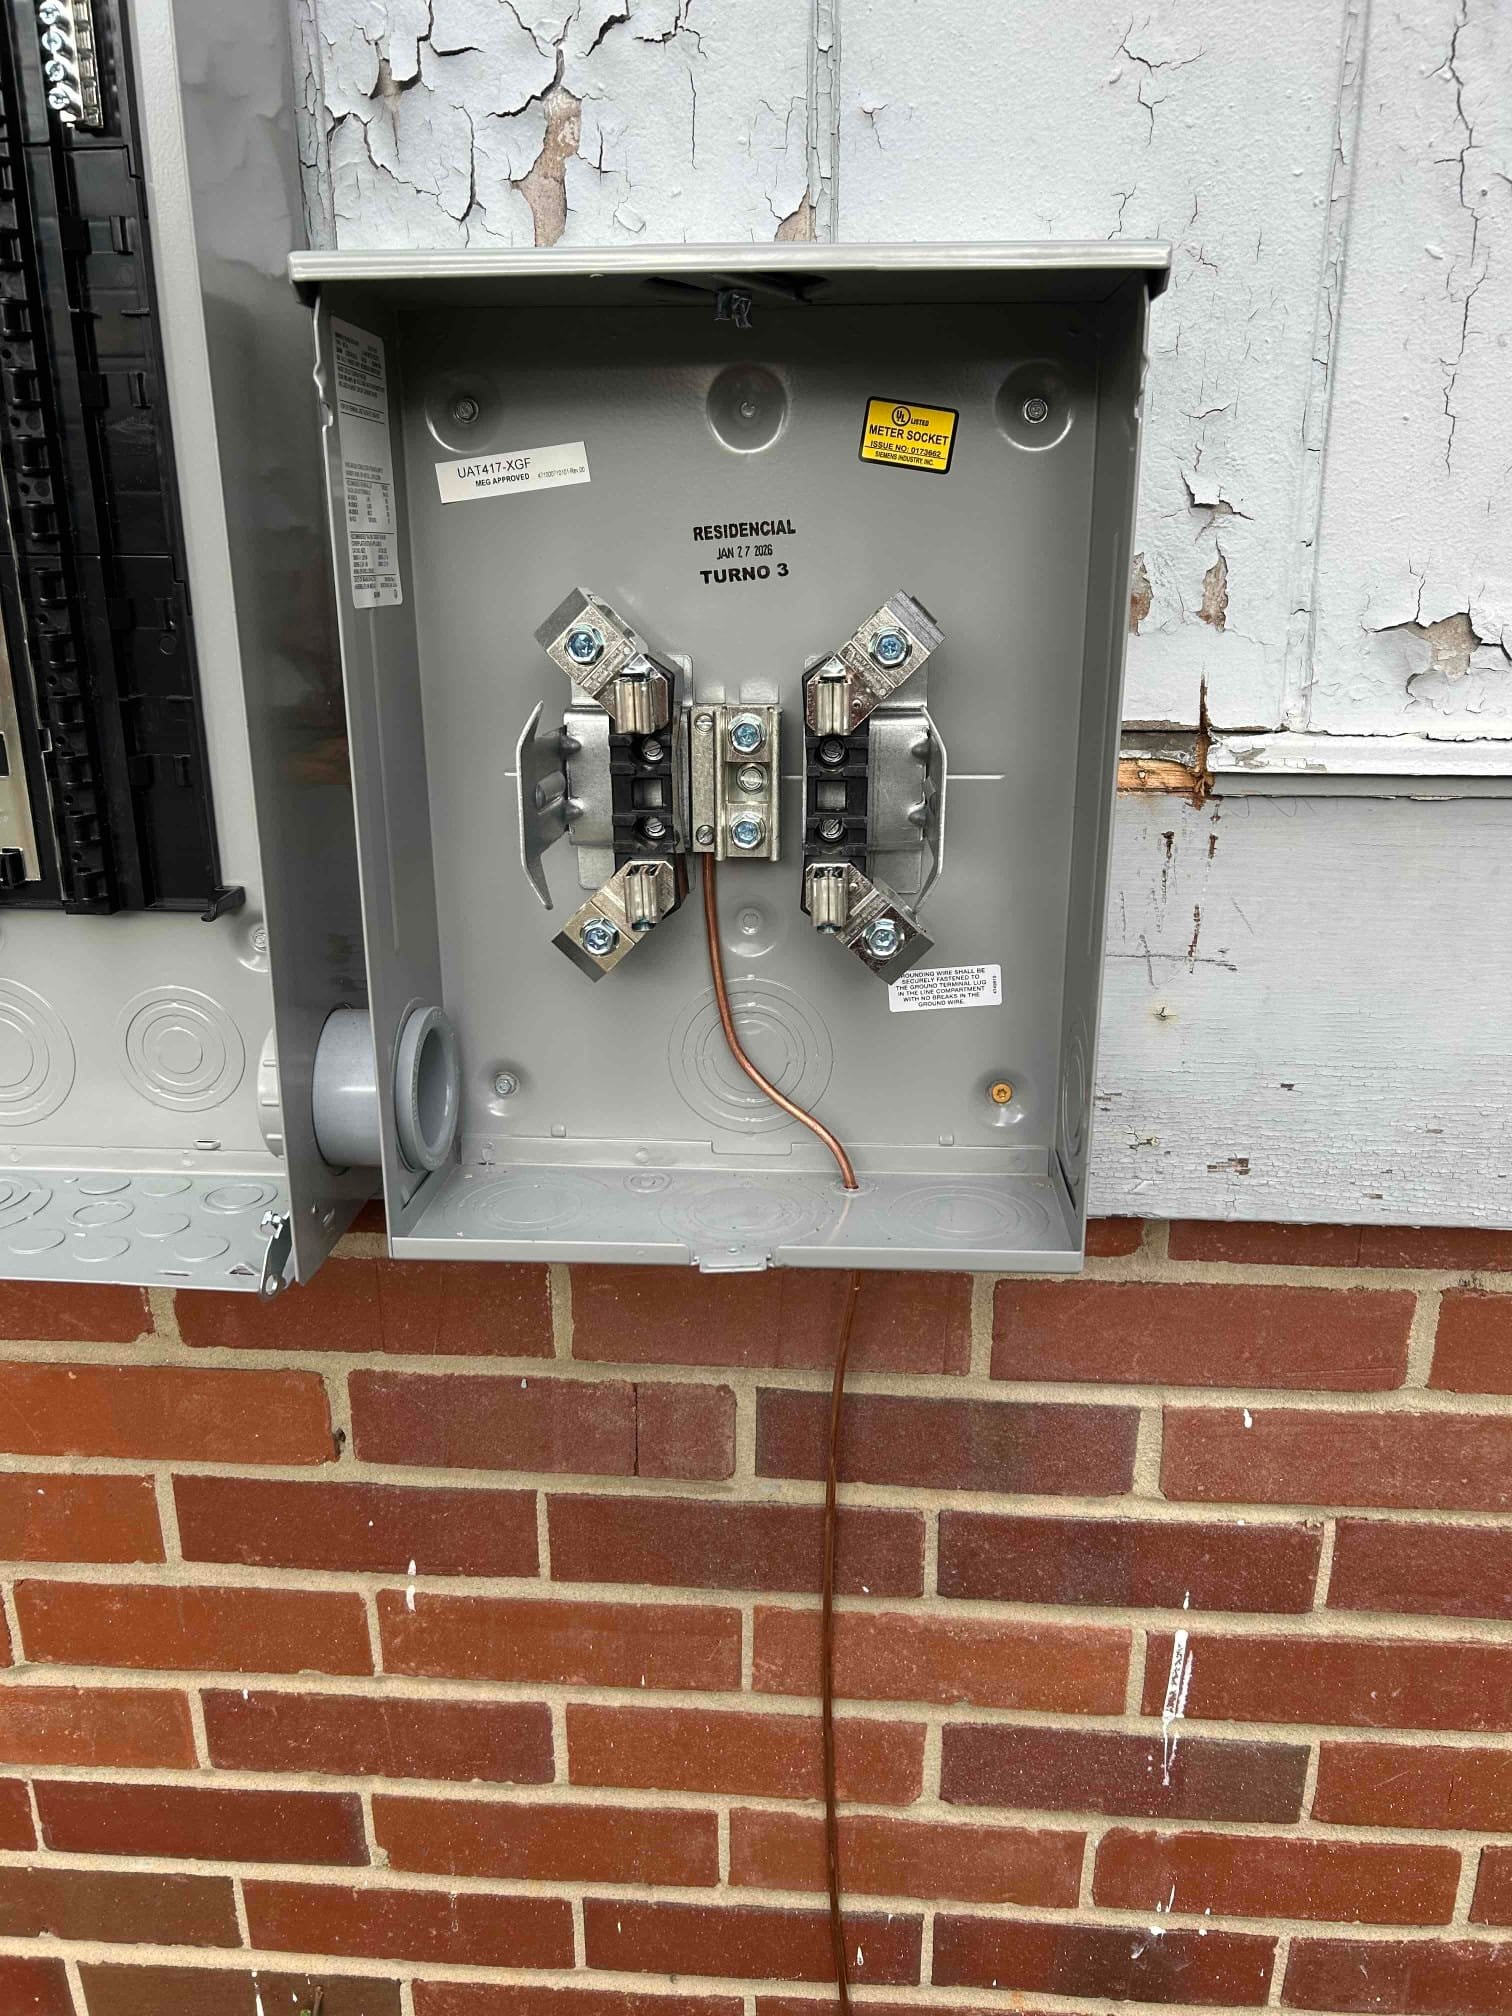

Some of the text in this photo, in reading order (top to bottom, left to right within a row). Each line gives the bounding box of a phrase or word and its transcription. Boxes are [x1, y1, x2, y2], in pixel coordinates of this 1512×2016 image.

[910, 418, 930, 427] LISTED
[869, 424, 950, 446] METER SOCKET
[870, 440, 894, 451] ISSUE
[875, 450, 898, 460] SIEMENS
[457, 457, 532, 479] UAT417-XGF
[475, 478, 492, 488] MEG
[492, 472, 530, 485] APPROVED
[693, 519, 797, 542] RESIDENCIAL
[717, 547, 735, 560] JAN
[754, 543, 774, 557] 2026
[700, 562, 789, 585] TURNO 3
[901, 971, 935, 979] ROUNDING
[935, 985, 986, 994] COMPARTMENT
